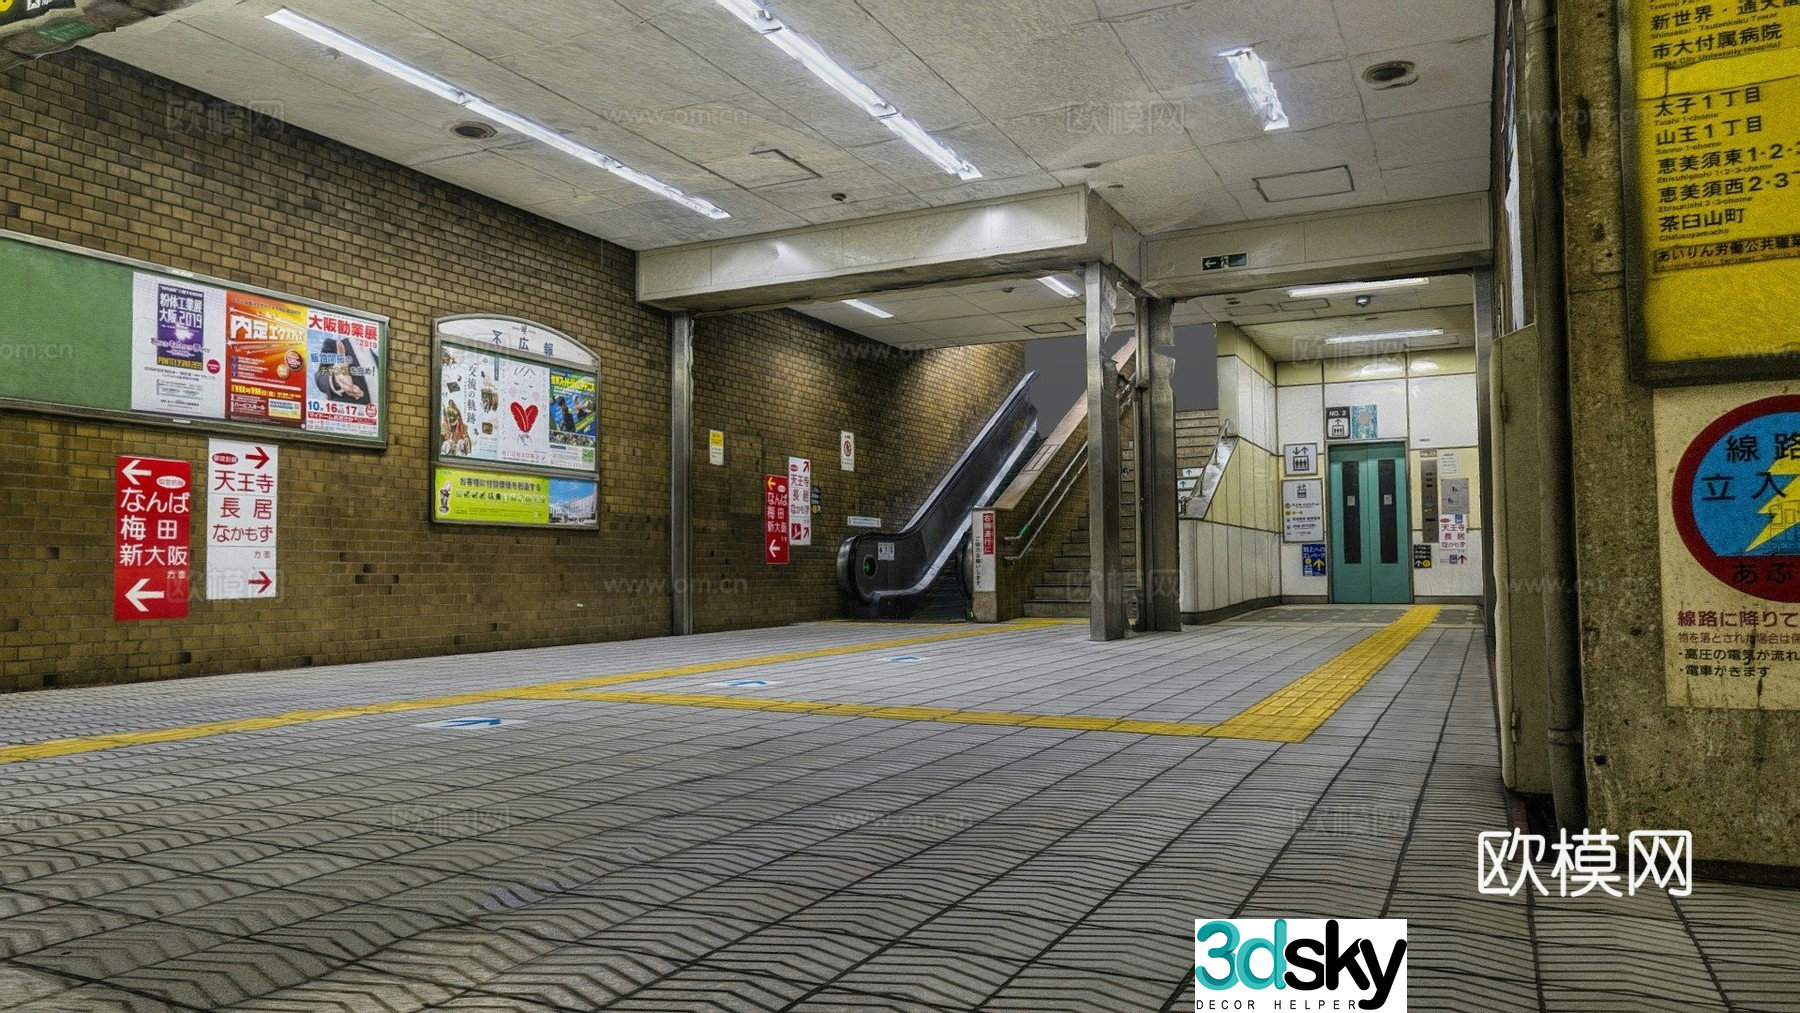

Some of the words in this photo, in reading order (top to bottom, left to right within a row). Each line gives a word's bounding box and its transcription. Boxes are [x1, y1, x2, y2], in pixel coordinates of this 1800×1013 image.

[1652, 22, 1783, 60] 市大付属病院
[1655, 86, 1760, 117] 太子1丁目
[1657, 115, 1762, 147] 山王1丁目
[1659, 207, 1746, 233] 茶臼山町
[309, 314, 377, 340] 大阪勧業展
[214, 470, 275, 494] 天王寺
[120, 487, 190, 514] なんば
[220, 497, 273, 520] 長居
[120, 515, 178, 540] 梅田
[213, 523, 273, 543] なかもず
[119, 544, 188, 566] 新大阪
[1678, 610, 1799, 628] 線路に降りて
